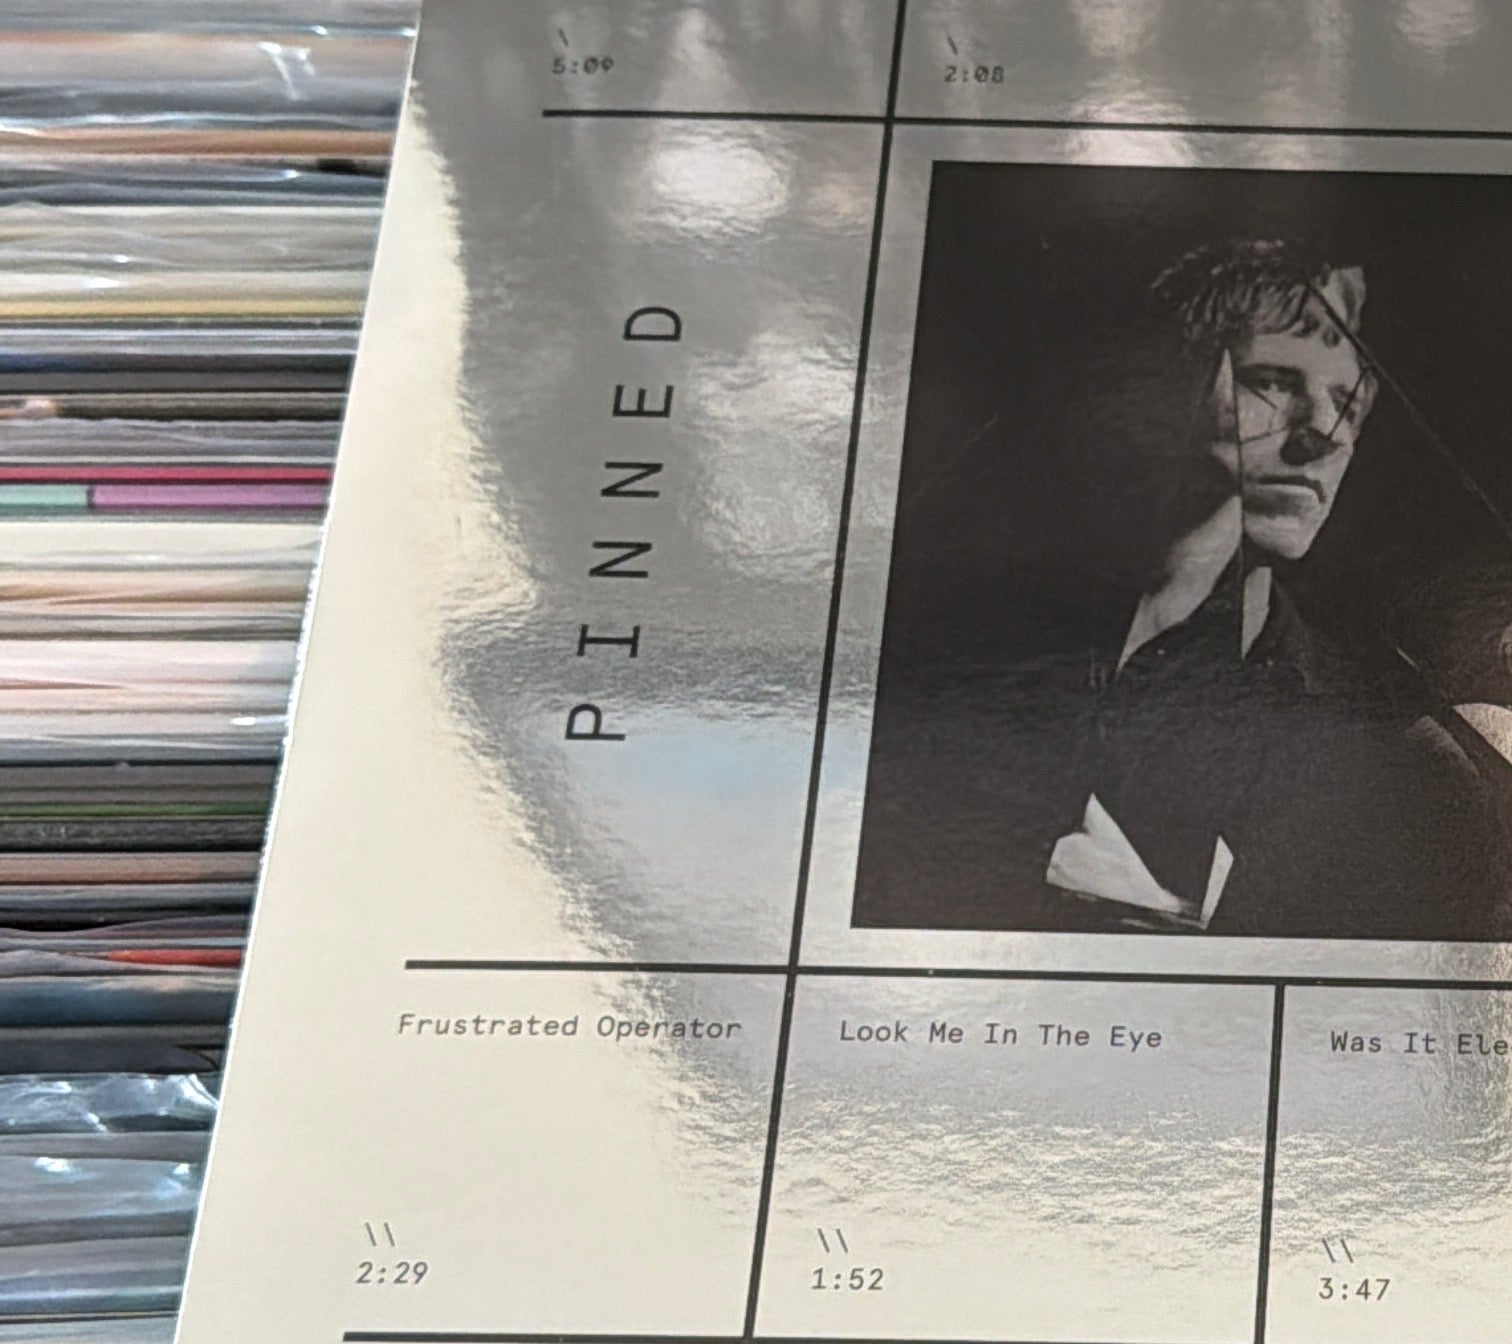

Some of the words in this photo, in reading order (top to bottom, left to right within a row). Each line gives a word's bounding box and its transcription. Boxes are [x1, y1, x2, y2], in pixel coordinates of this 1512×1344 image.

[565, 305, 683, 743] PINNED
[398, 1013, 579, 1036] Frustrated
[597, 1015, 742, 1042] Operator
[840, 1020, 908, 1043] Look
[929, 1022, 964, 1044] Me
[984, 1023, 1018, 1044] In
[1039, 1024, 1090, 1046] The
[1110, 1026, 1162, 1052] Eye
[1330, 1031, 1382, 1053] Was
[1404, 1032, 1436, 1054] It
[356, 1261, 428, 1284] 2:29
[811, 1267, 884, 1291] 1:52
[1318, 1278, 1390, 1301] 3:47
